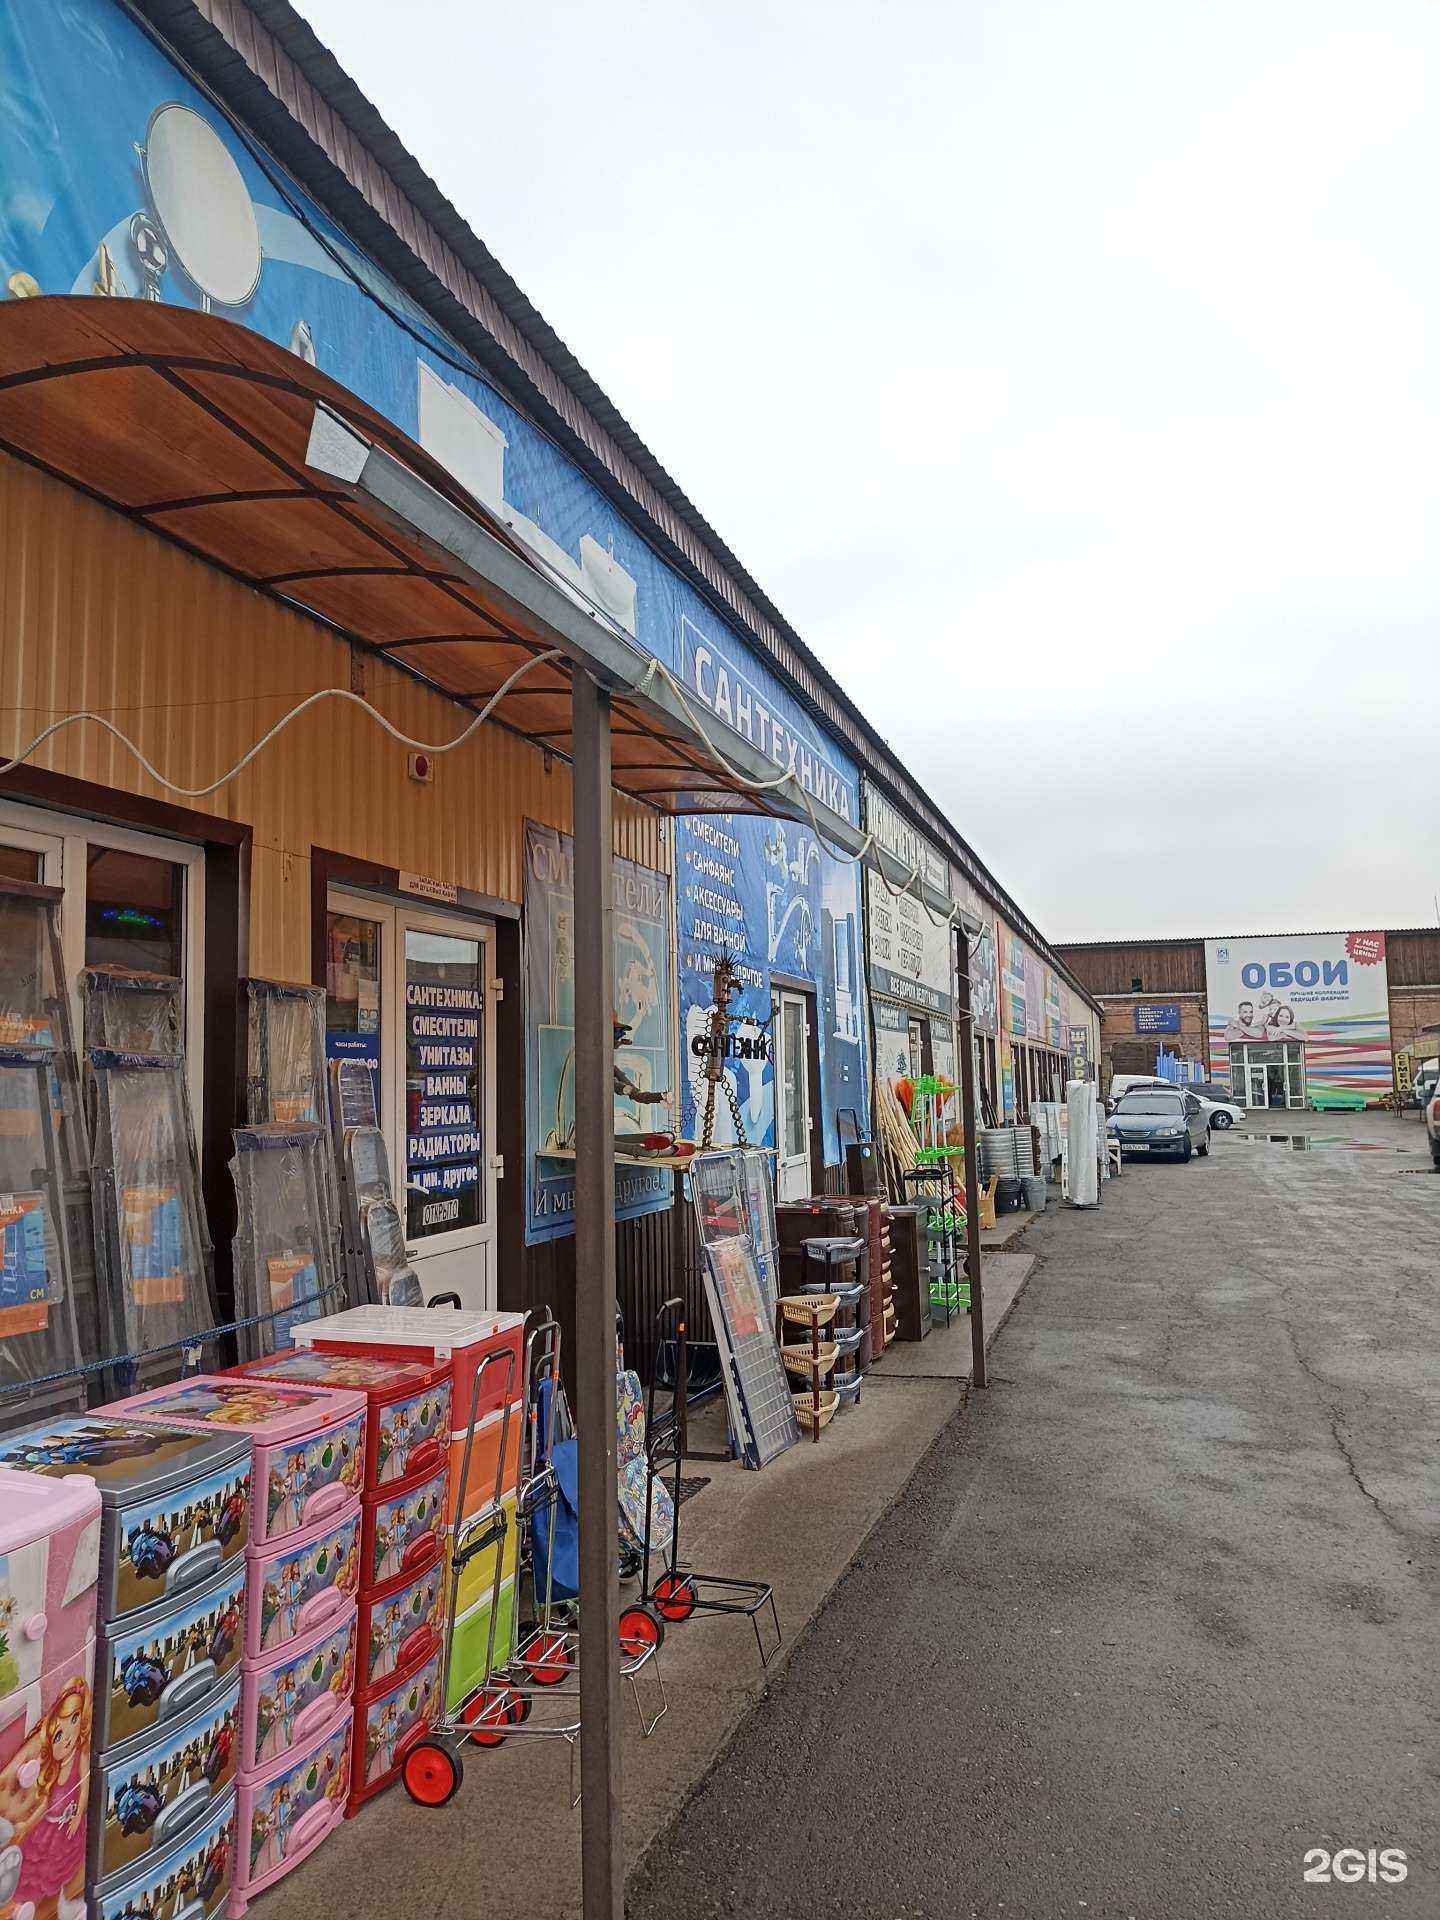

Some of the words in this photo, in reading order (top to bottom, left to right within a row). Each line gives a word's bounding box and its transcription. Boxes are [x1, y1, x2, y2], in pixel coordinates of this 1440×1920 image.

[695, 647, 850, 821] САНТЕХНИКА
[693, 817, 740, 859] СМЕСИТЕЛИ
[693, 851, 735, 888] САНФАЯНС
[693, 885, 743, 921] АКСЕССУАРЫ
[694, 918, 712, 942] ДЛЯ
[713, 925, 746, 952] ВАННОЙ
[1241, 959, 1348, 990] ОБОИ
[407, 984, 483, 1010] САНТЕХНИКА:
[412, 1015, 478, 1038] СМЕСИТЕЛИ
[419, 1045, 473, 1066] УНИТАЗЫ
[426, 1075, 467, 1096] ВАННЫ
[1397, 1054, 1409, 1090] СЕМЕНА
[420, 1104, 471, 1127] ЗЕРКАЛА
[409, 1132, 481, 1161] РАДИАТОРЫ
[422, 1171, 441, 1188] мн.
[443, 1166, 478, 1190] другое
[424, 1200, 459, 1224] ОТКРЫТО
